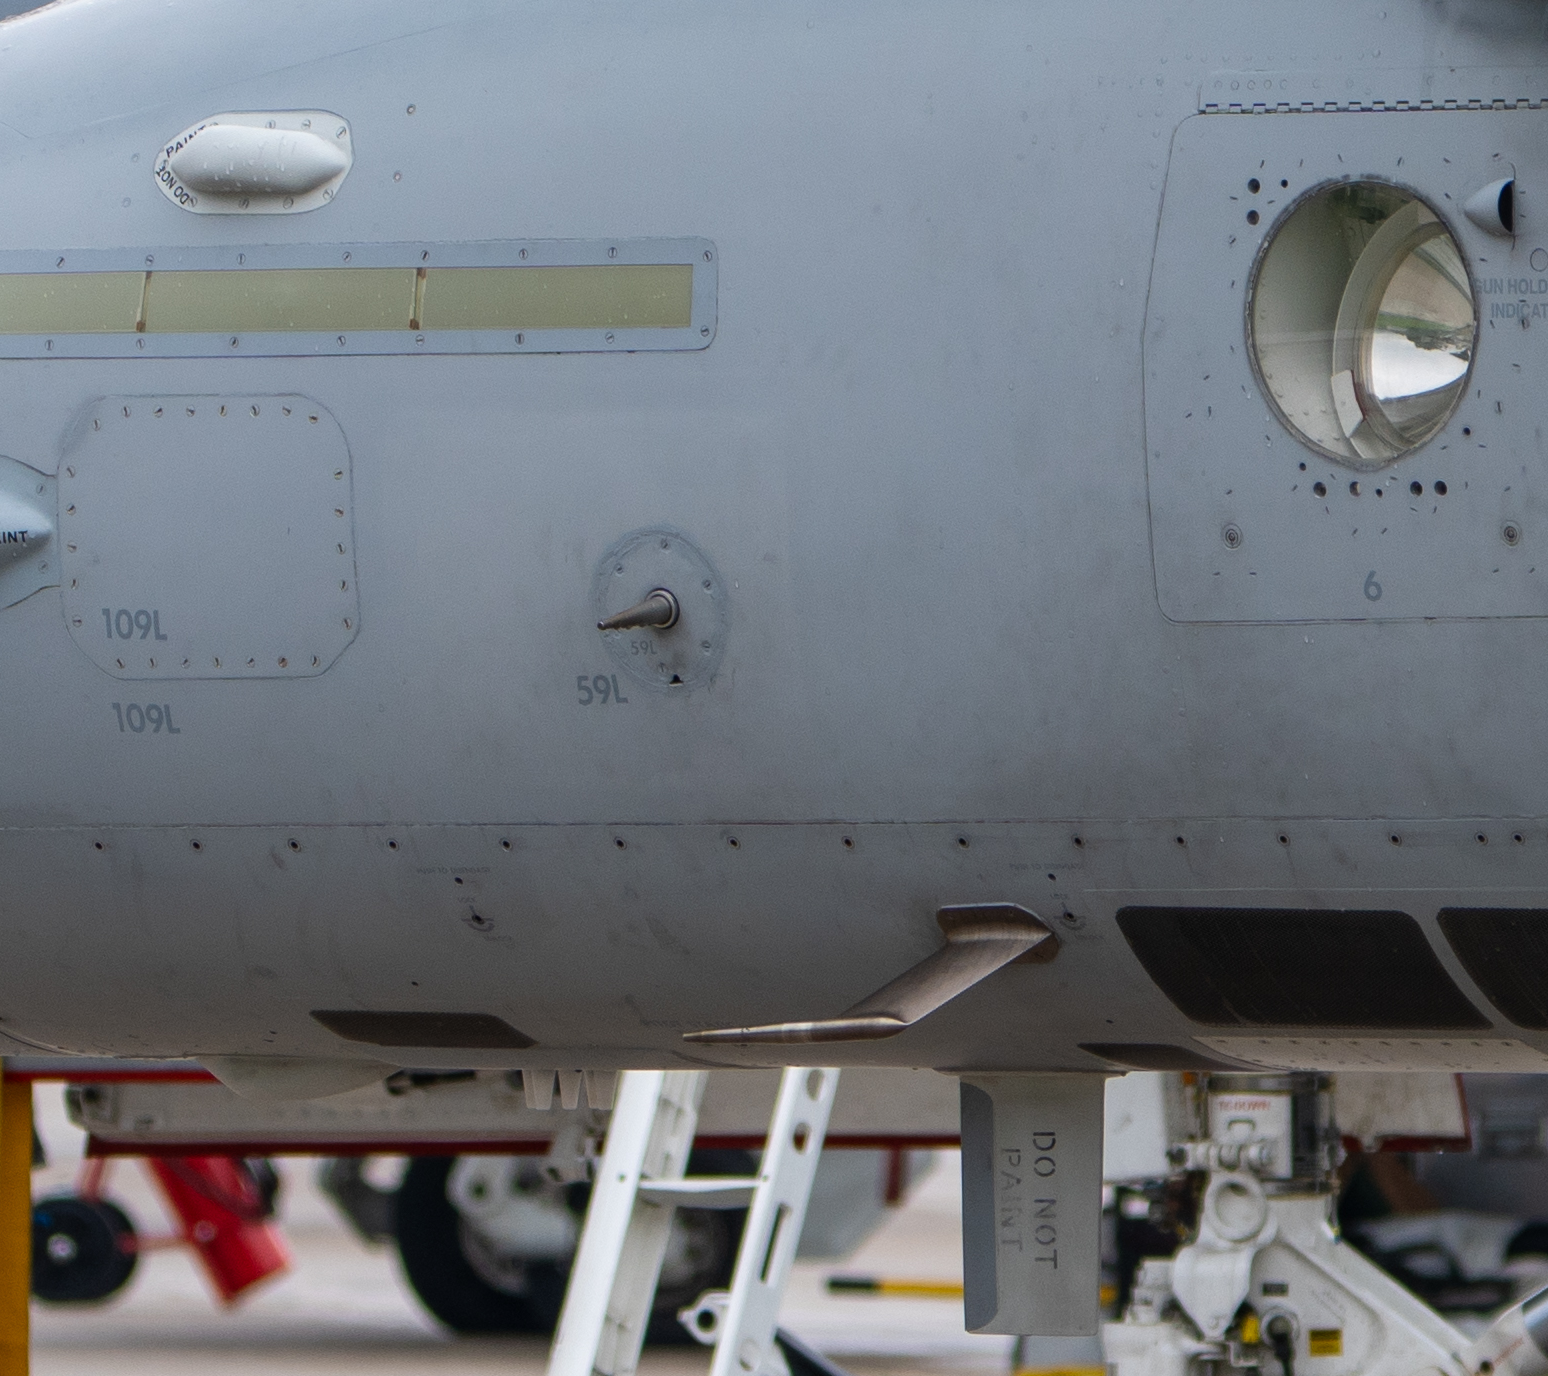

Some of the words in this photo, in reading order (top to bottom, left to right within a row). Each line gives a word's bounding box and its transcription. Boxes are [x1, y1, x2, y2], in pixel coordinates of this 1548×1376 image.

[1364, 570, 1383, 602] 6
[102, 608, 168, 641] 109L
[630, 641, 657, 656] 59L
[576, 674, 629, 707] 59L
[112, 702, 181, 734] 109L
[1033, 1132, 1057, 1178] DO
[1034, 1198, 1058, 1270] NOT
